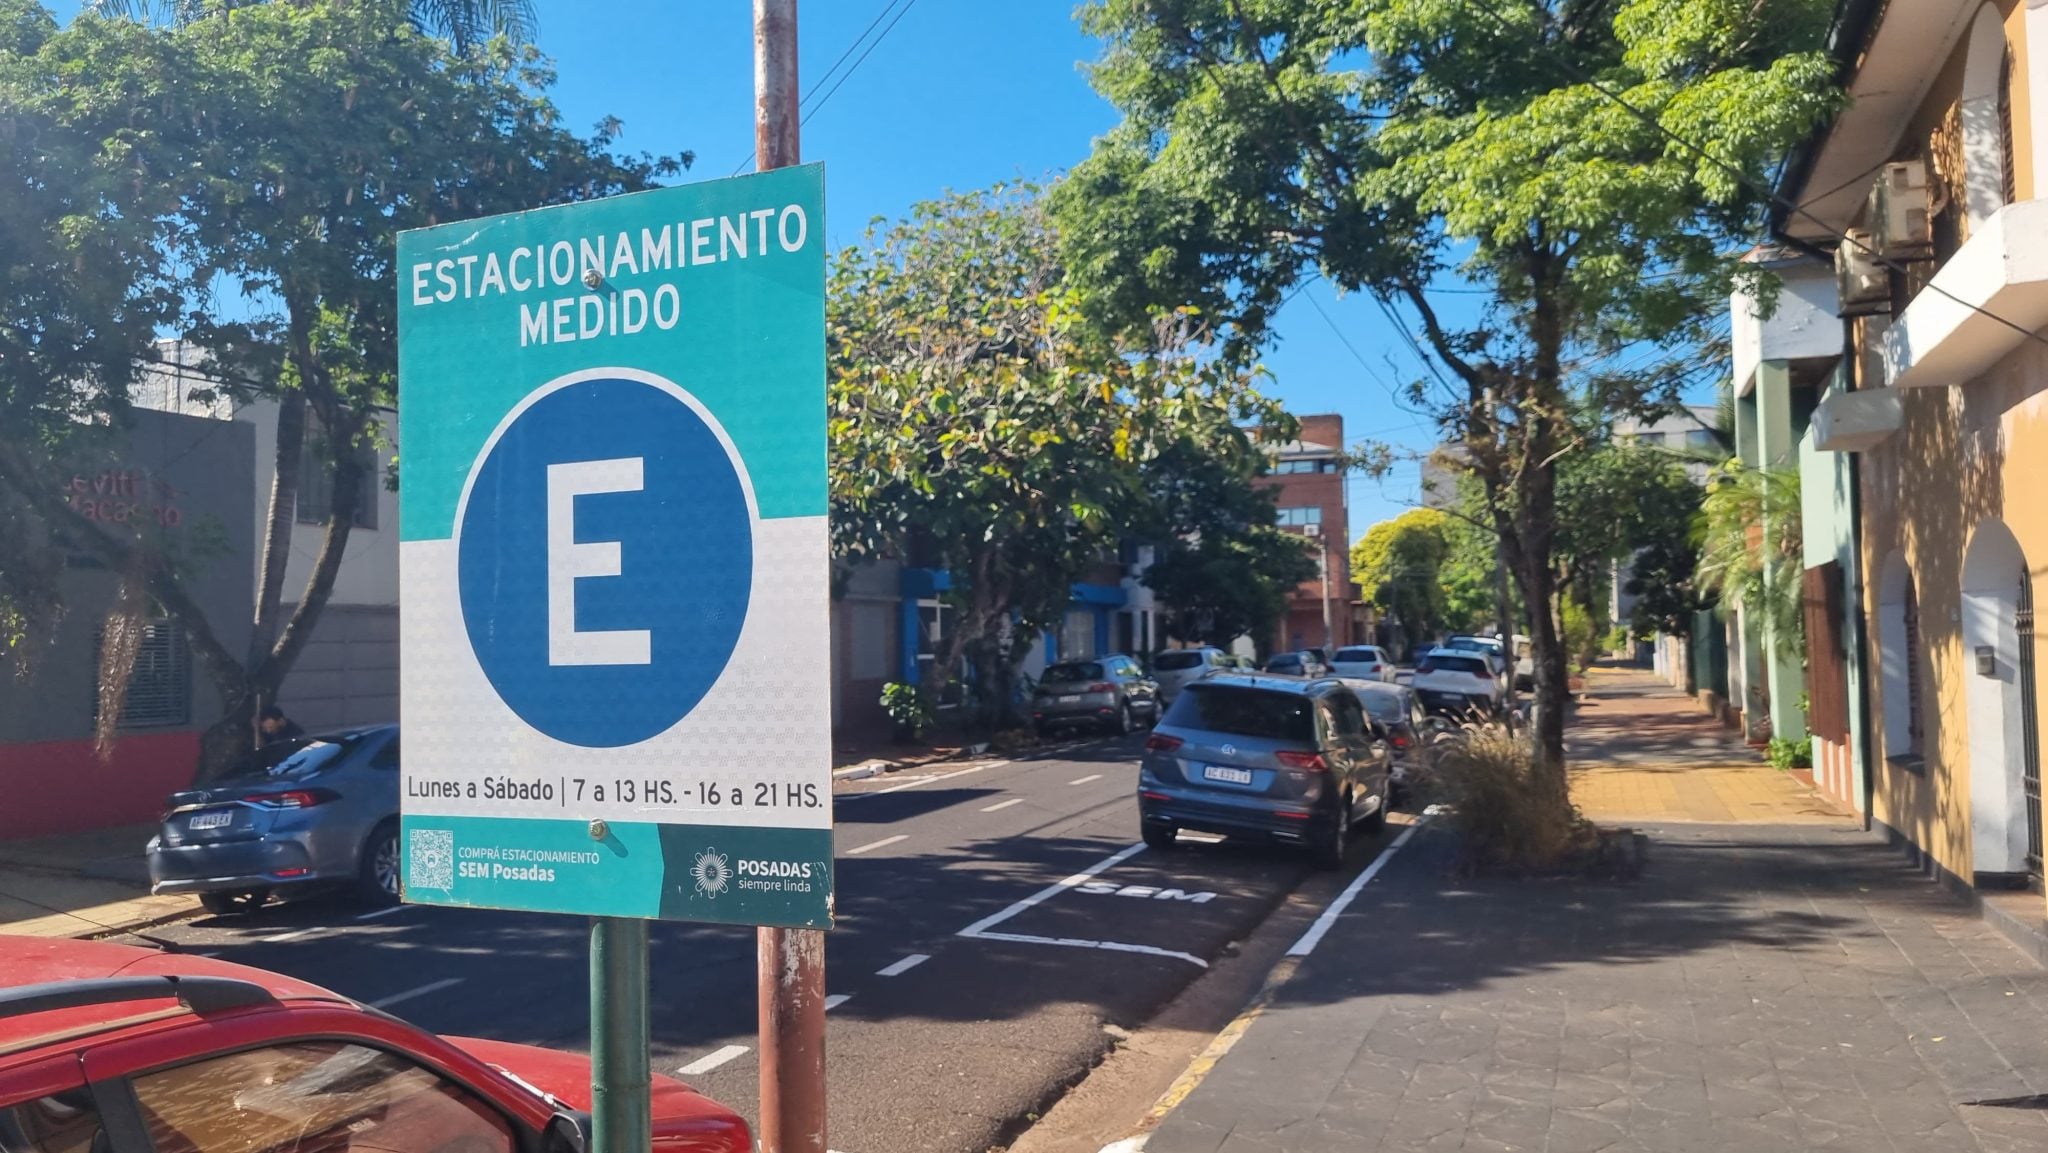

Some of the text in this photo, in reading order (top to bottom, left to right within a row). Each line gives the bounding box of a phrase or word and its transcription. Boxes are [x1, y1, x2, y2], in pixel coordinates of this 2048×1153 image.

[412, 204, 808, 307] ESTACIONAMIENTO
[520, 283, 681, 347] MEDIDO
[547, 456, 652, 667] E
[408, 775, 461, 799] Lunes
[466, 781, 477, 799] a
[483, 775, 554, 801] Sábado
[572, 778, 586, 801] 7
[593, 784, 605, 802] a
[614, 779, 636, 803] 13
[644, 780, 678, 804] HS.
[699, 781, 722, 806] 16
[730, 787, 744, 806] a
[754, 782, 777, 807] 21
[786, 783, 823, 808] HS.
[458, 845, 600, 865] COMPRÁ ESTACIONAMIENTO
[458, 861, 556, 882] SEM Posadas
[737, 859, 812, 879] POSADAS
[738, 878, 811, 893] siempre linda
[1073, 881, 1218, 904] SEM
